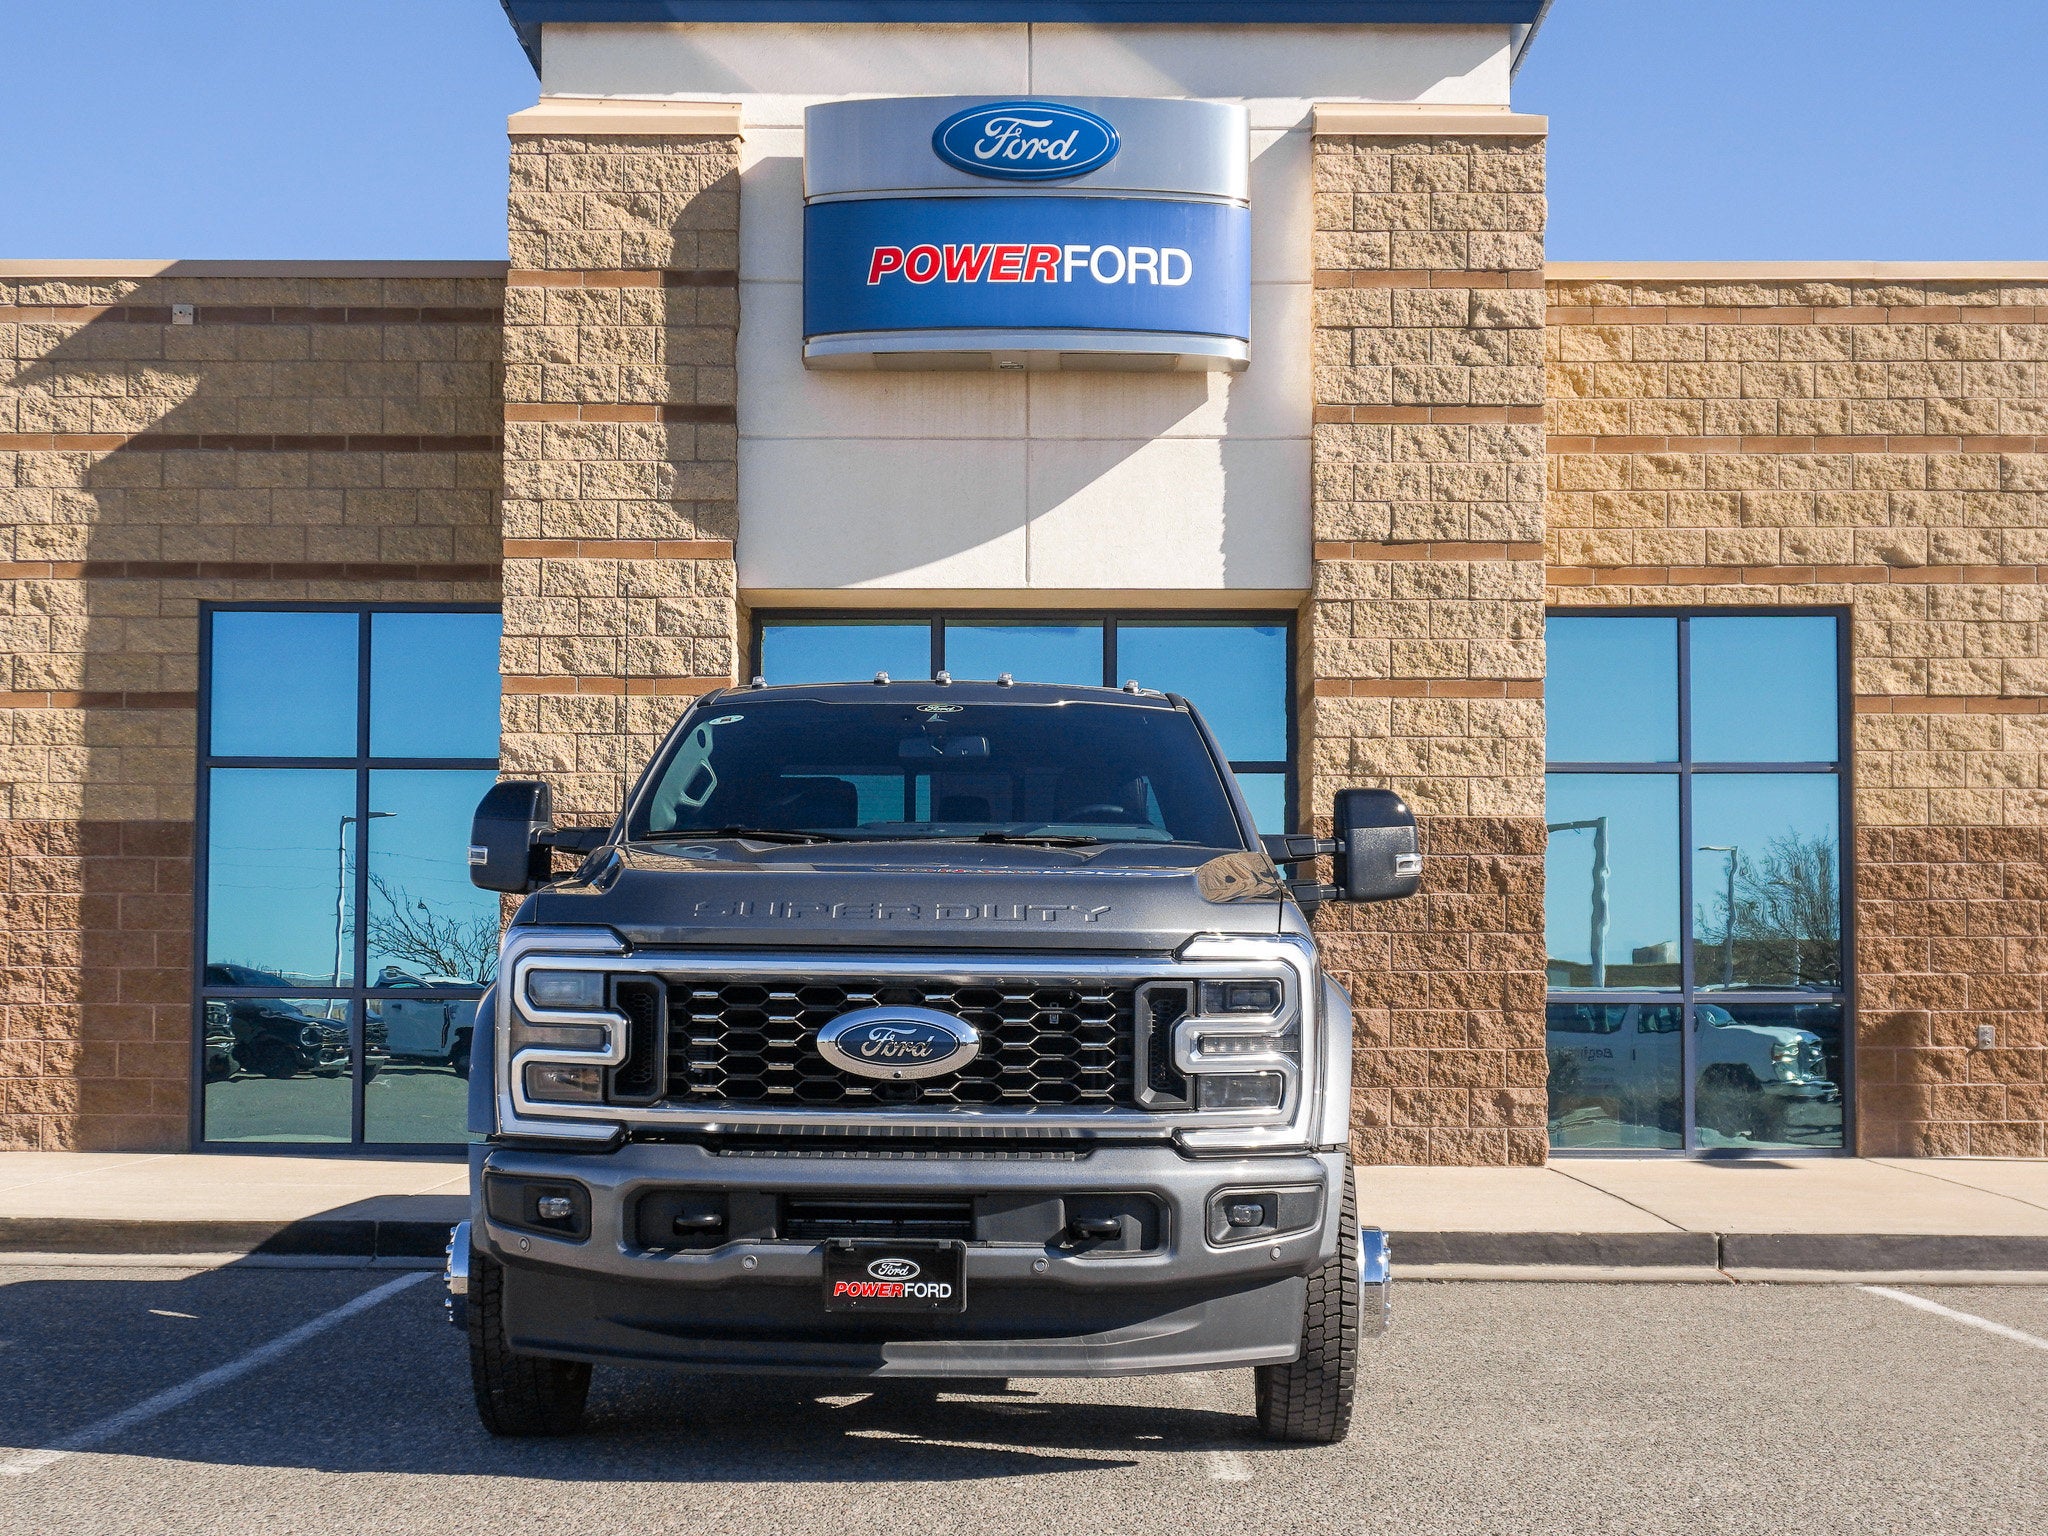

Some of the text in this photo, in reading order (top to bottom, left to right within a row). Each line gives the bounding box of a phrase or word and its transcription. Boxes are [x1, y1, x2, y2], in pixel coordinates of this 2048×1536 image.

[974, 117, 1079, 161] Ford
[866, 243, 1193, 286] POWERFORD
[936, 903, 1111, 921] DUTY
[861, 1027, 935, 1057] Ford
[877, 1261, 909, 1276] Ford
[833, 1281, 952, 1298] POWERFORD
